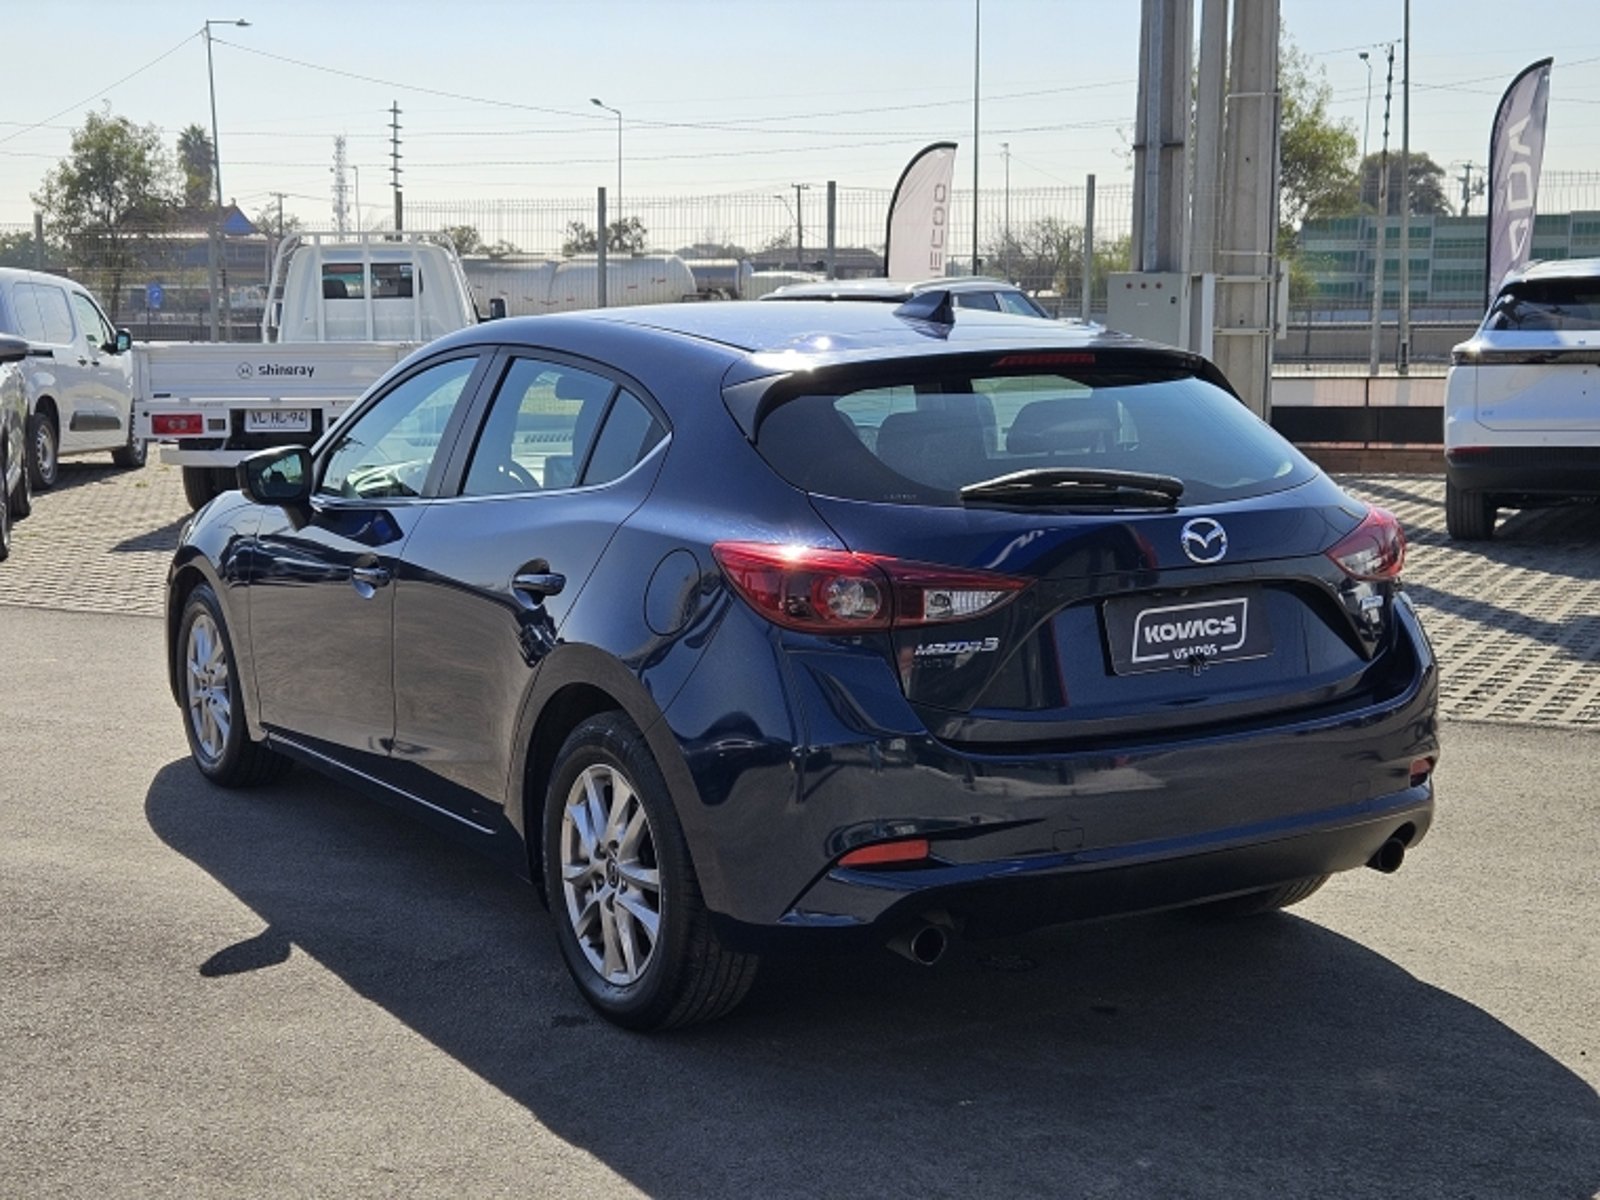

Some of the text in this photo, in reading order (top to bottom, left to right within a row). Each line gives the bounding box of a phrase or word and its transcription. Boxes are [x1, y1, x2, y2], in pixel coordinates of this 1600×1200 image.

[930, 183, 946, 277] ECOO
[258, 364, 315, 378] shineray
[1144, 615, 1237, 643] KOVACS
